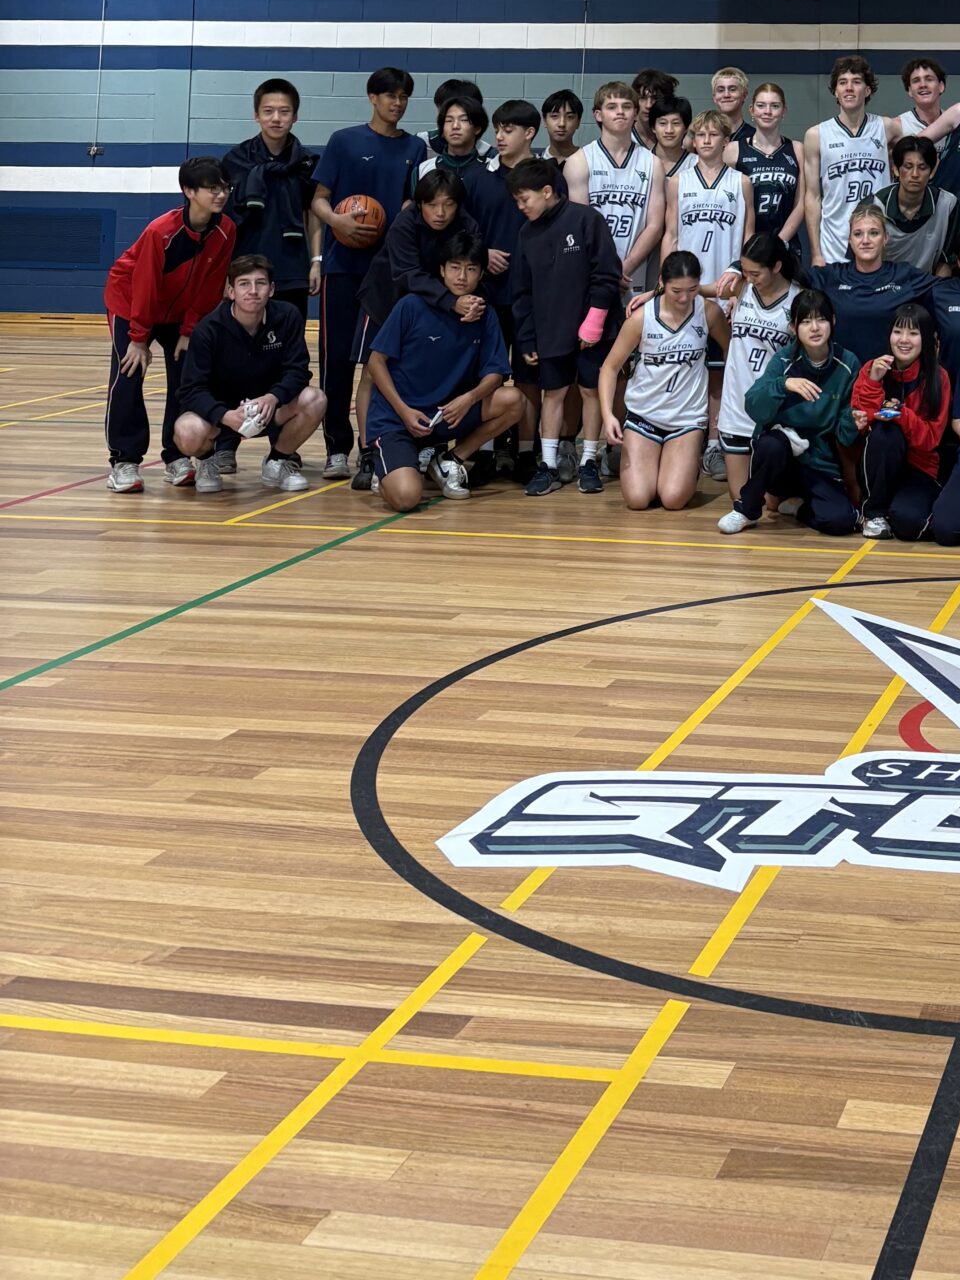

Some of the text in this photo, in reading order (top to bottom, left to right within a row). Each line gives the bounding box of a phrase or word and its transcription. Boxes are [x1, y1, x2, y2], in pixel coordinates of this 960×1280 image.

[828, 158, 886, 181] STORM
[601, 183, 636, 191] SHENTON
[748, 172, 796, 190] TORM
[846, 180, 873, 203] 30
[758, 193, 783, 213] 24
[681, 209, 736, 231] STORM
[701, 230, 714, 253] 1
[744, 315, 779, 329] SHENTON
[657, 343, 693, 353] SHENTON
[733, 322, 790, 352] STORM
[644, 348, 704, 368] STORM
[748, 347, 767, 372] 4
[665, 370, 680, 393] 1
